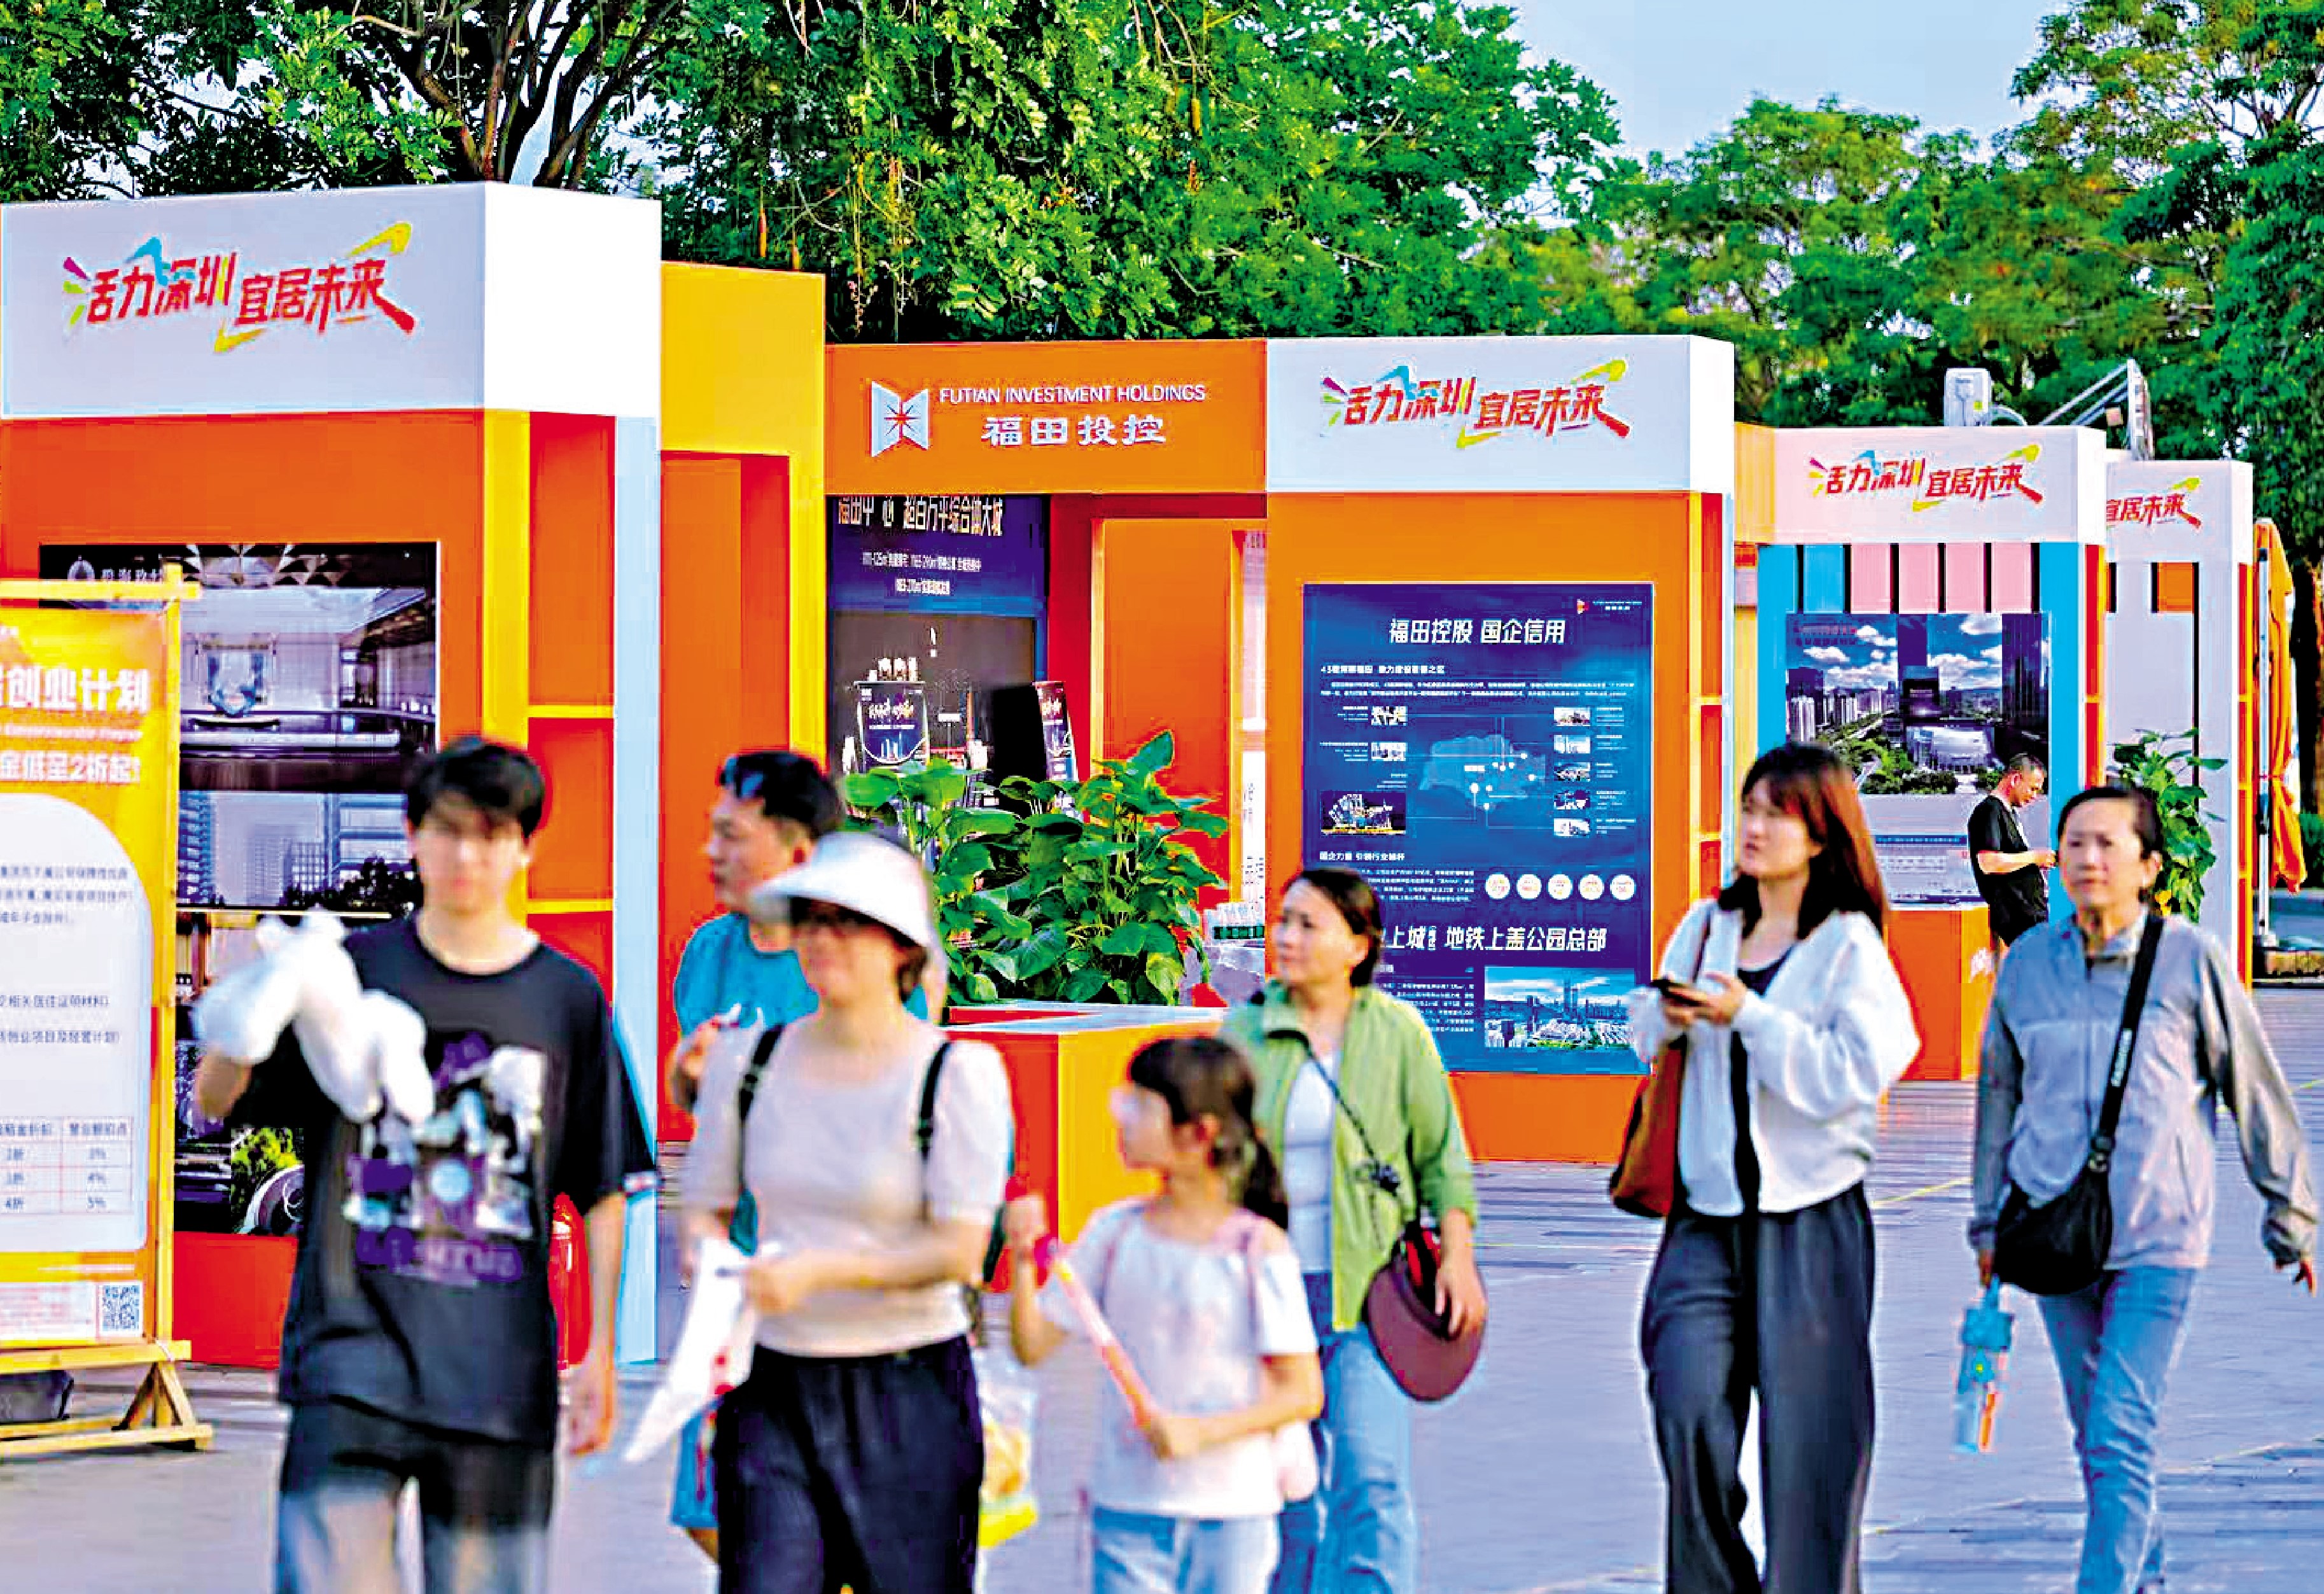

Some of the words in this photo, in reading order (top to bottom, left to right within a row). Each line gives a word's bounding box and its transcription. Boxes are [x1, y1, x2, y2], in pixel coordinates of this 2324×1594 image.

[62, 237, 237, 327] 活力深圳
[229, 242, 417, 337] 宜居未来
[940, 387, 1000, 404] FUTIAN
[1005, 386, 1112, 403] INVESTMENT
[1117, 384, 1206, 402] HOLDINGS
[1322, 365, 1477, 433] 活力深圳
[1471, 375, 1630, 439] 宜居未来
[982, 415, 1166, 446] 福田投控
[1810, 451, 1925, 496] 活力深圳
[1924, 457, 2043, 506] 宜居未来
[1390, 618, 1474, 644] 福田控股
[1481, 618, 1565, 644] 国企信用
[0, 666, 150, 715] 创业计划
[1444, 926, 1607, 951] 地铁上盖公园总部
